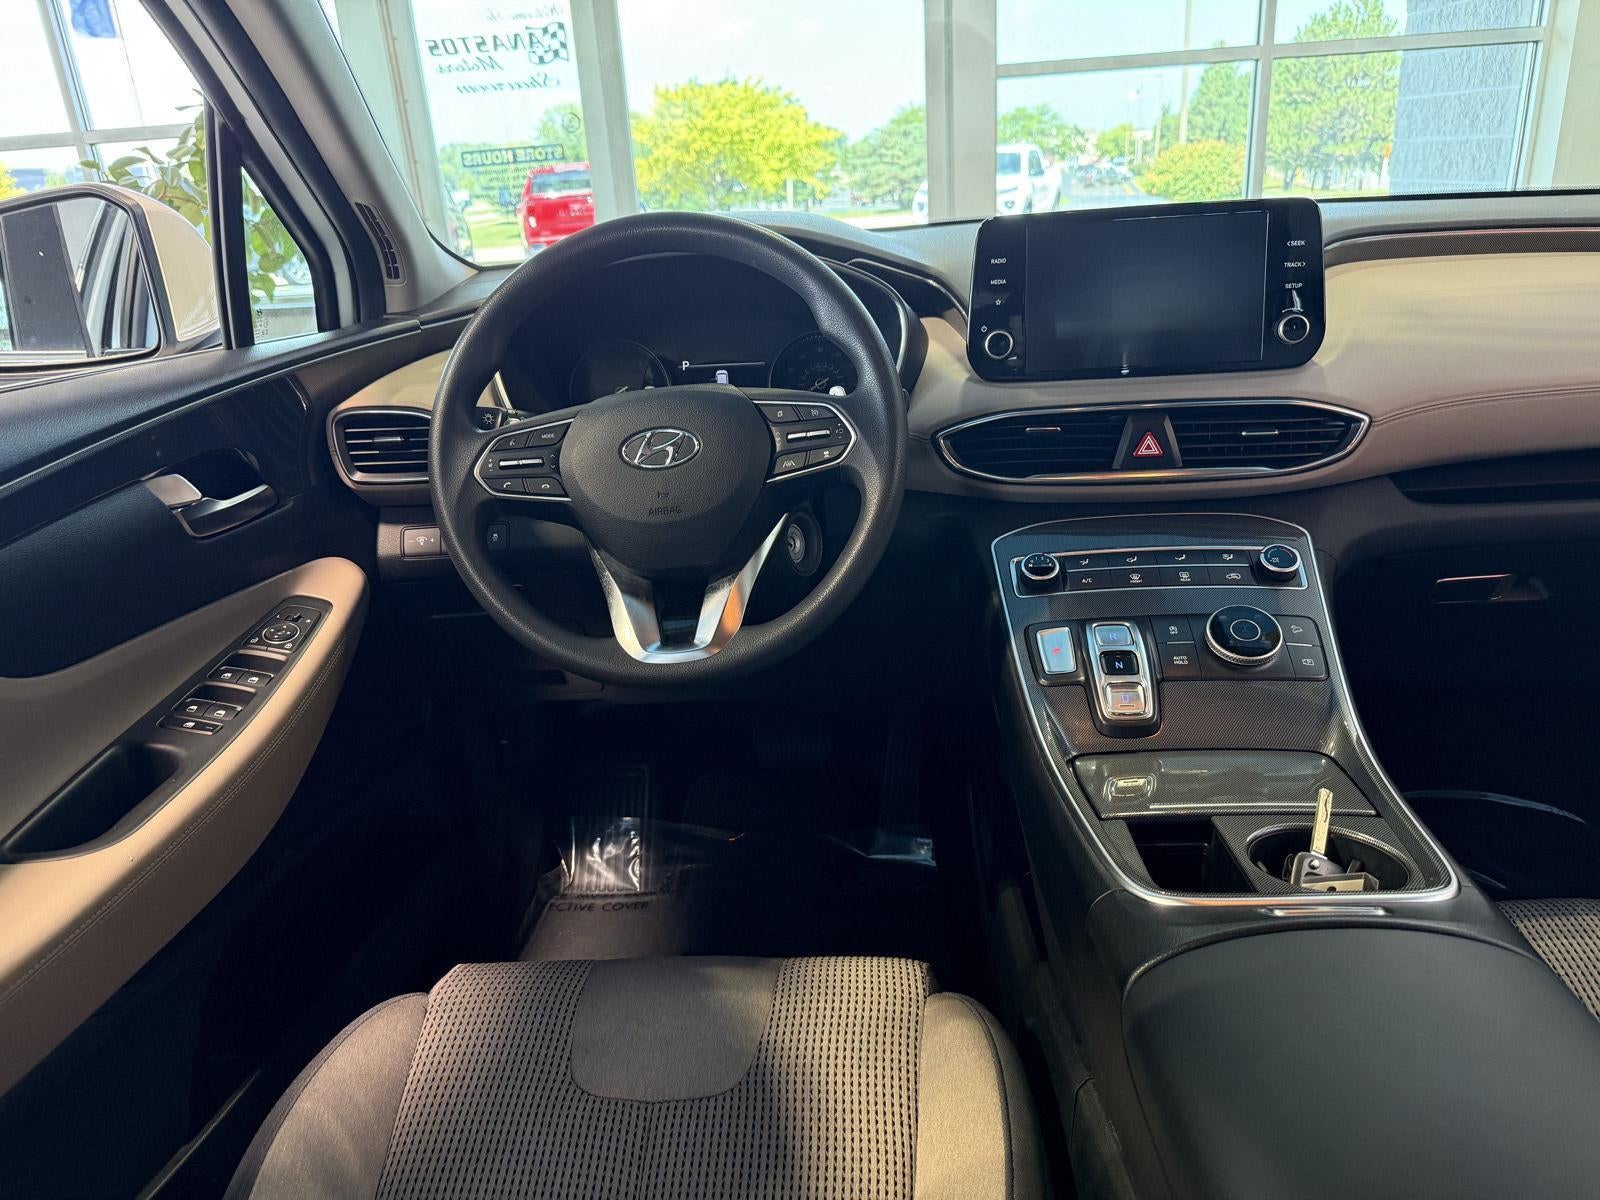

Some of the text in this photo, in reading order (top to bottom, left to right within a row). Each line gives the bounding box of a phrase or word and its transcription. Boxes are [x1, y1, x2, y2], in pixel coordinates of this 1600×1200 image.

[990, 257, 1007, 265] RADIO
[682, 360, 690, 371] P
[648, 505, 682, 517] AIRBAG
[1114, 661, 1124, 670] N
[601, 901, 649, 912] COVER
